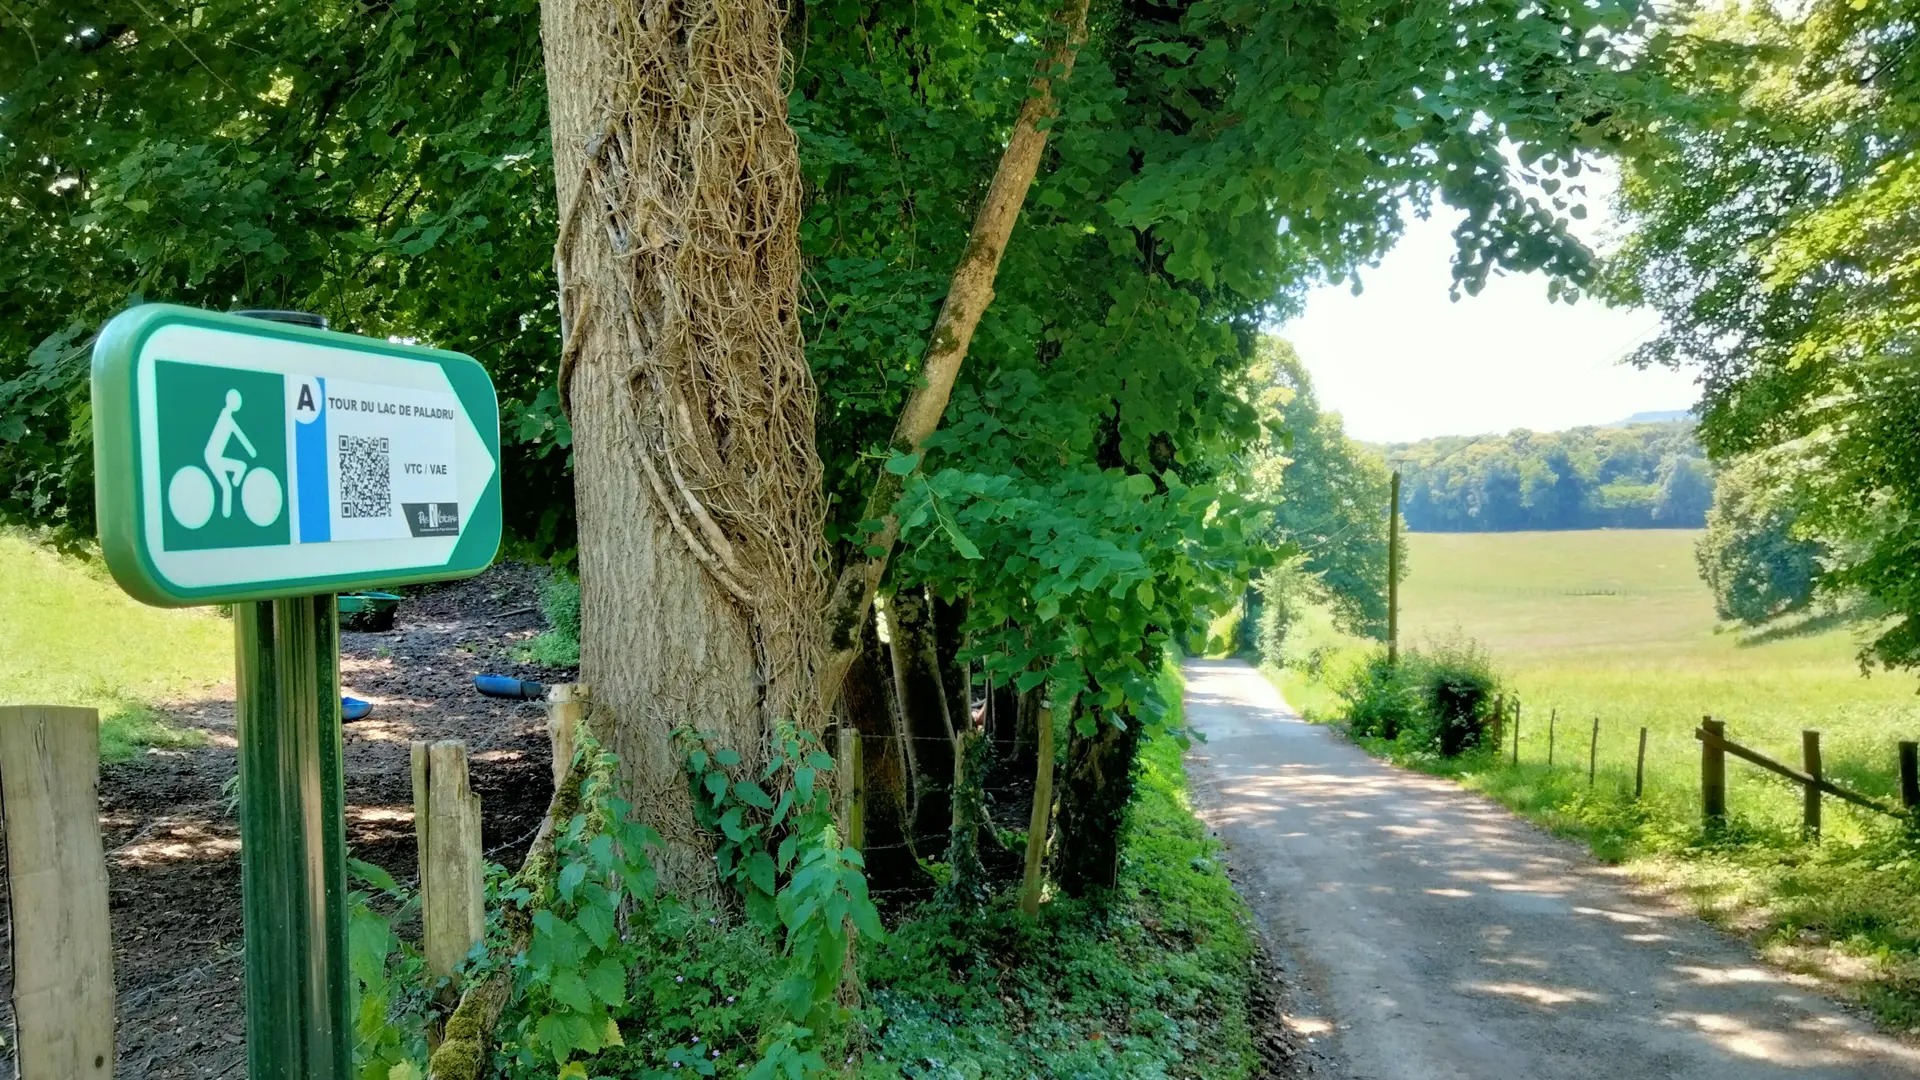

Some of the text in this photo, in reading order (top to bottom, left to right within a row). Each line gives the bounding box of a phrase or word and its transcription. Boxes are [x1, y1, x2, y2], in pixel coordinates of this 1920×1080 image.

[297, 384, 315, 411] A
[328, 397, 454, 420] TOUR DU LAC DE PALADRU
[404, 463, 422, 474] VTC
[429, 464, 447, 475] VAE
